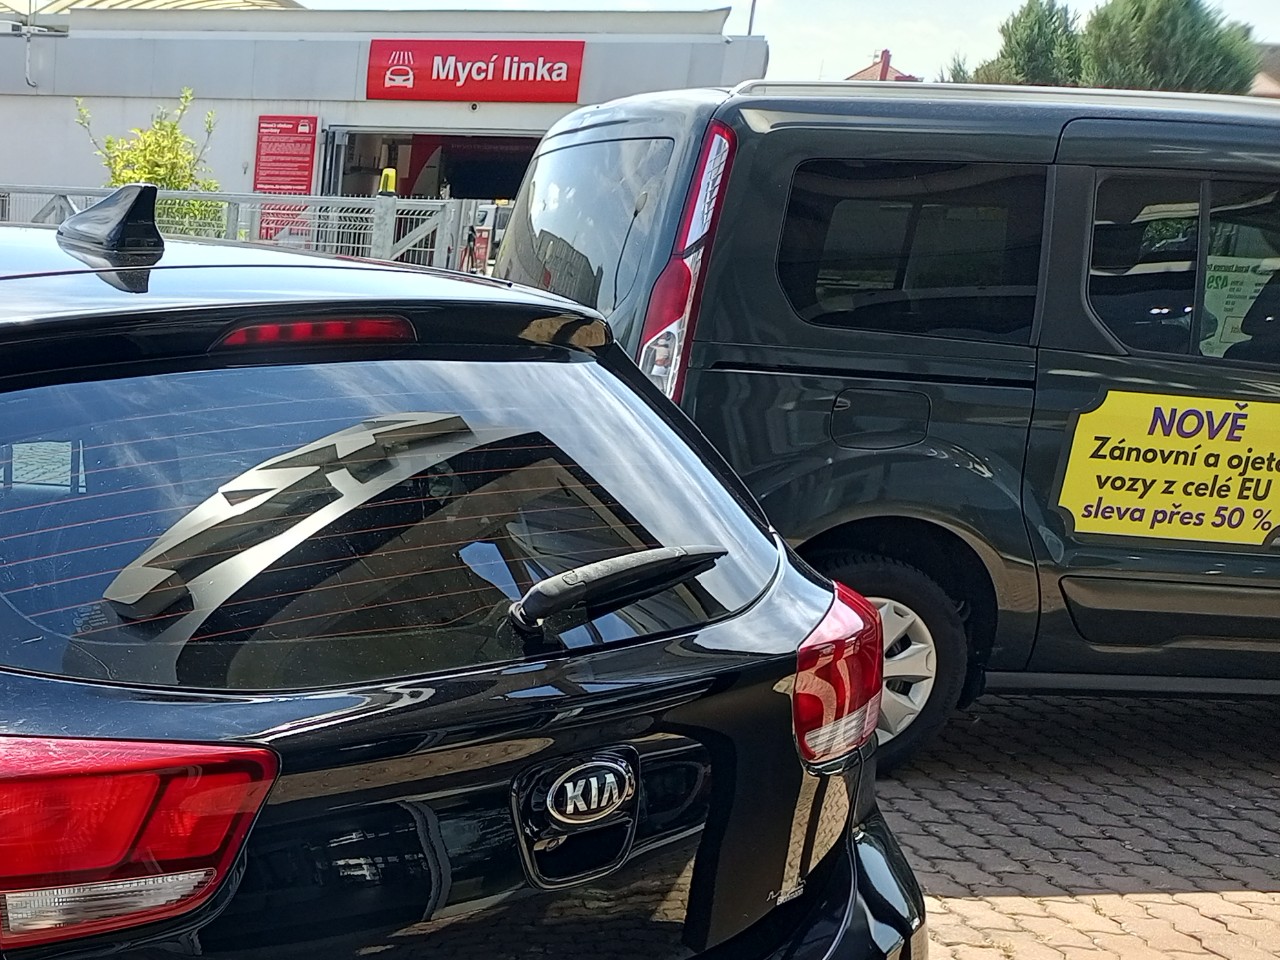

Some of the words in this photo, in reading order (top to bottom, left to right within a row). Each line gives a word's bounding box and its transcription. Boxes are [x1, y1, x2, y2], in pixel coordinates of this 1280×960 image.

[431, 54, 499, 87] Mycí
[503, 56, 568, 82] linka
[1147, 402, 1249, 442] NOVĚ
[1089, 435, 1202, 467] Zánovní
[1203, 452, 1220, 468] a
[1095, 474, 1157, 500] vozy
[1161, 480, 1177, 495] z
[1182, 474, 1233, 499] celé
[1237, 478, 1273, 501] EU
[1081, 497, 1145, 522] sleva
[1149, 503, 1205, 530] přes
[1211, 506, 1245, 529] 50
[1252, 508, 1273, 531] %
[564, 773, 621, 815] KIA
